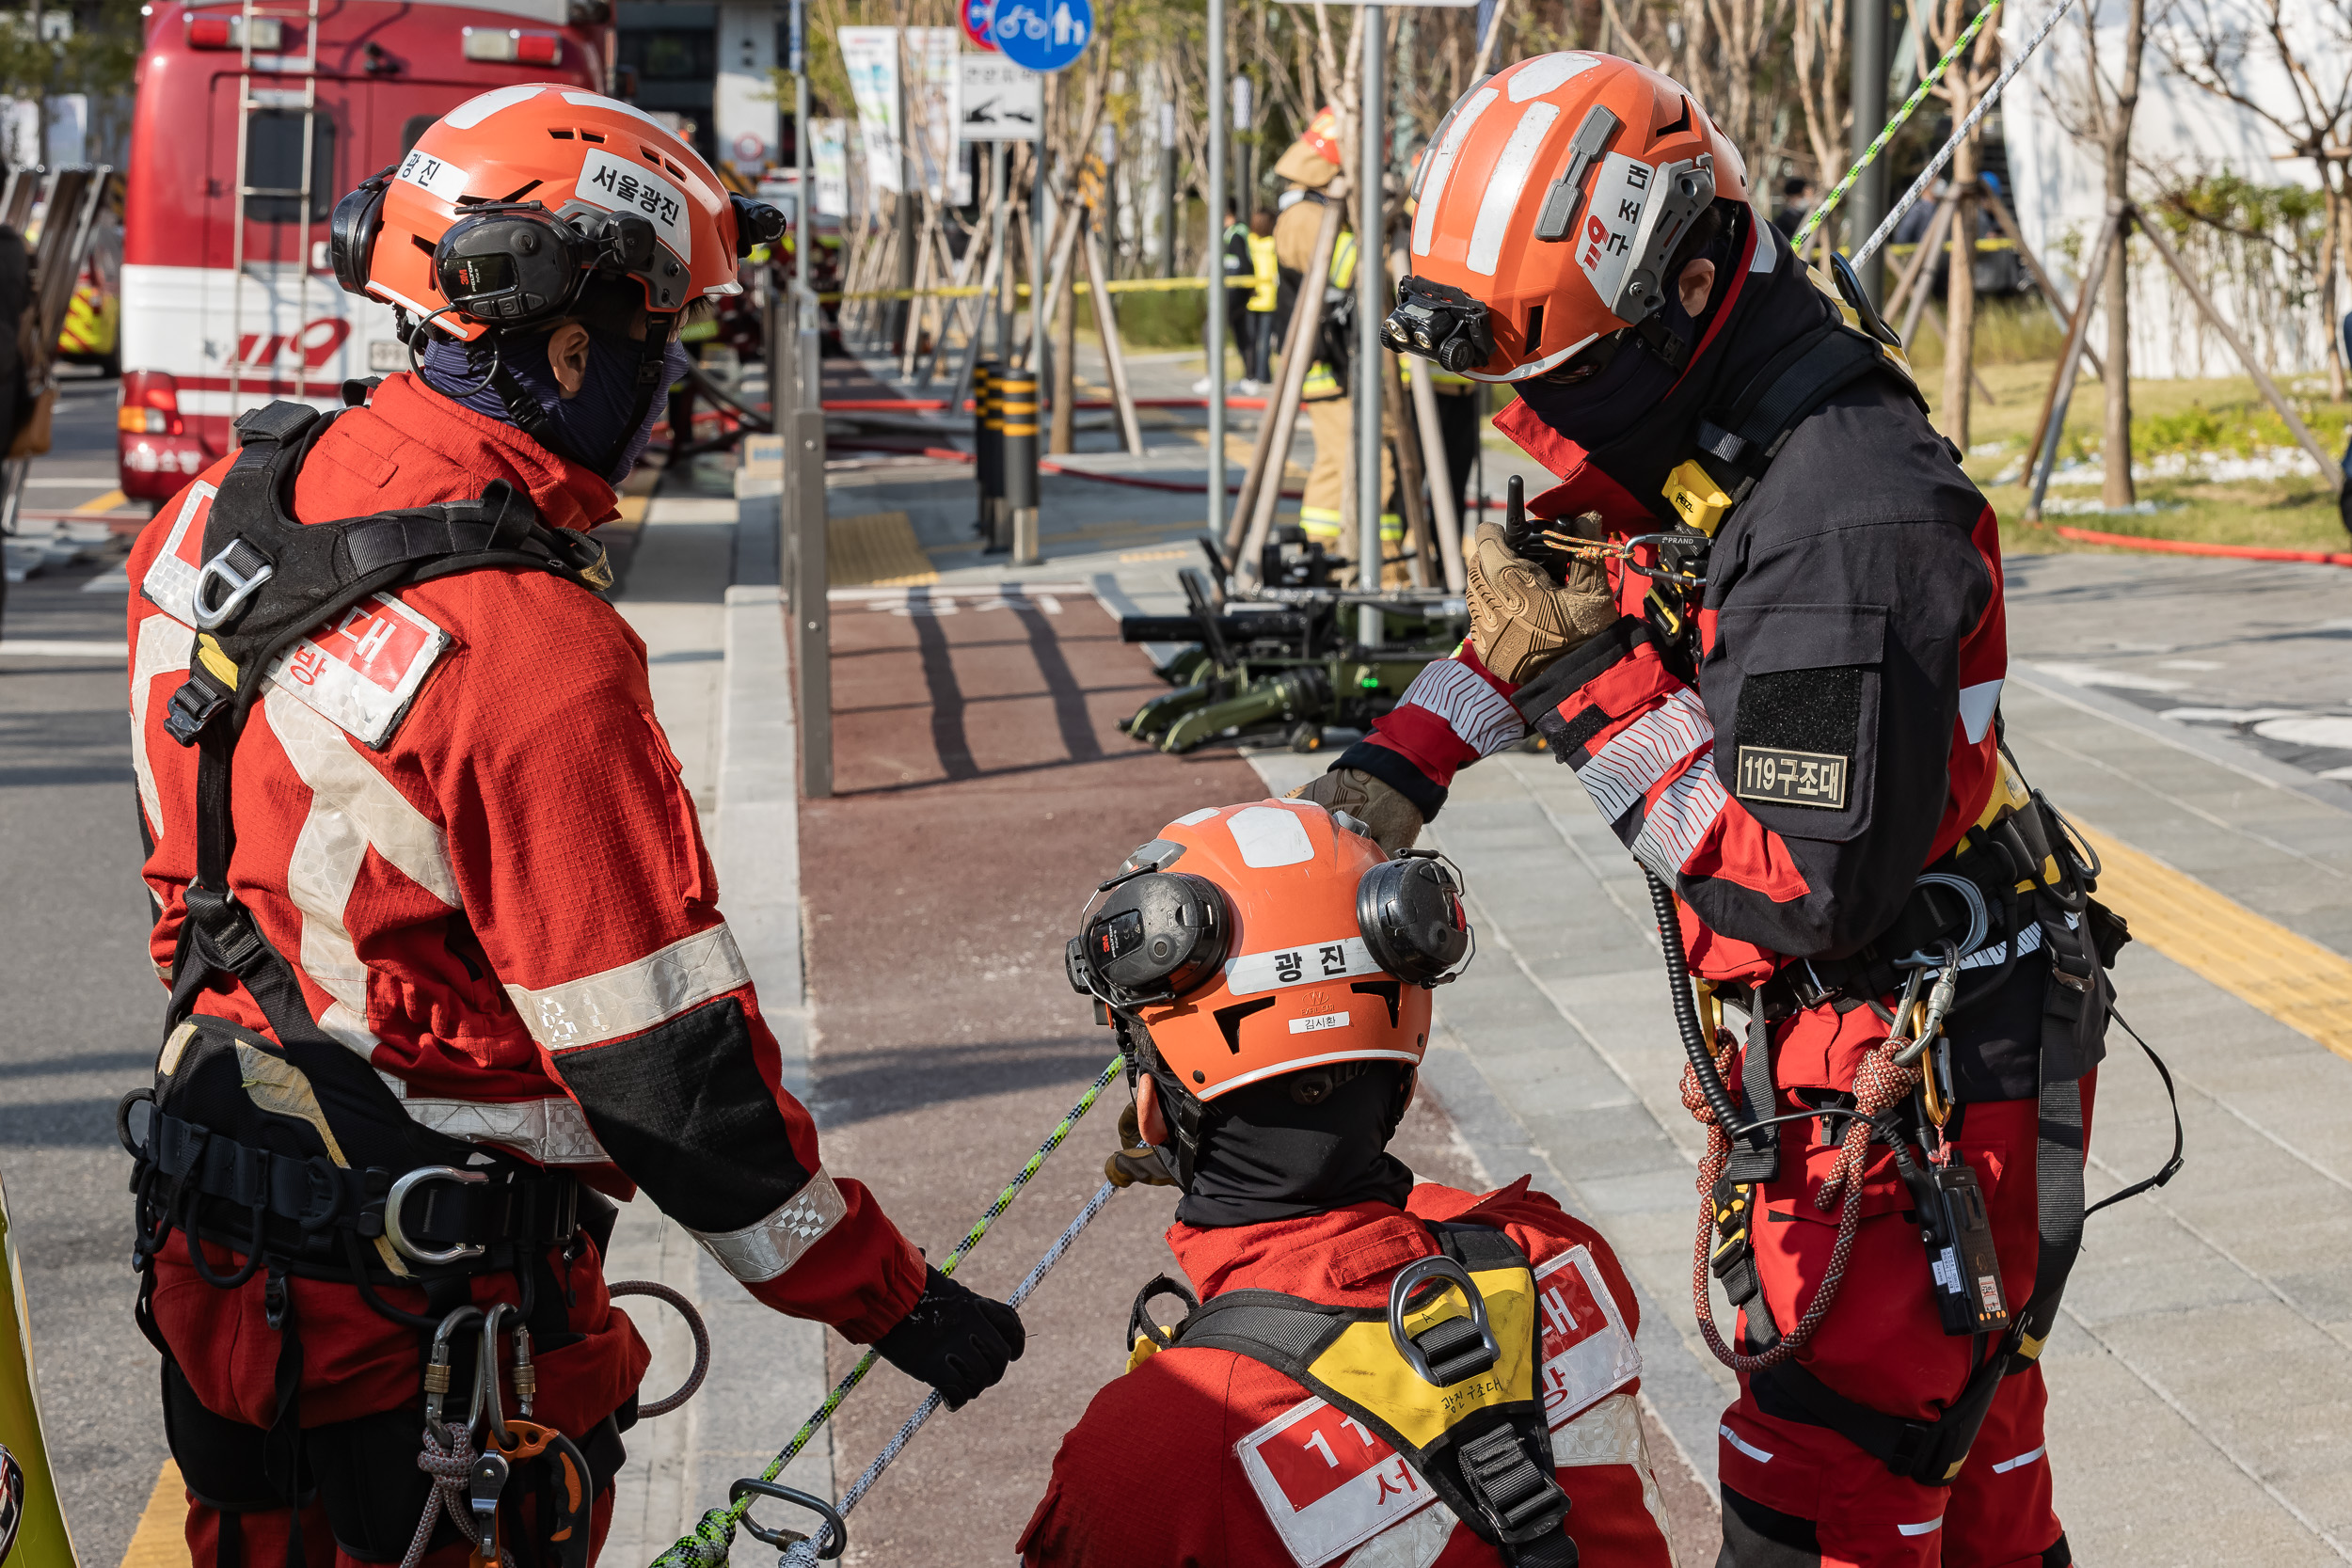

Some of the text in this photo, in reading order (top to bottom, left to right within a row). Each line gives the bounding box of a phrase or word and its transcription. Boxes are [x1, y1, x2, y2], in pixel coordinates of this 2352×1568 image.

[402, 153, 441, 186] 광진
[592, 165, 679, 228] 서울광진
[458, 269, 469, 285] 3M
[320, 606, 397, 665] 대
[1744, 756, 1840, 801] 119구조대
[1275, 944, 1346, 982] 광진
[1305, 1016, 1336, 1030] 김시환
[1441, 1377, 1503, 1413] 광진 구조대
